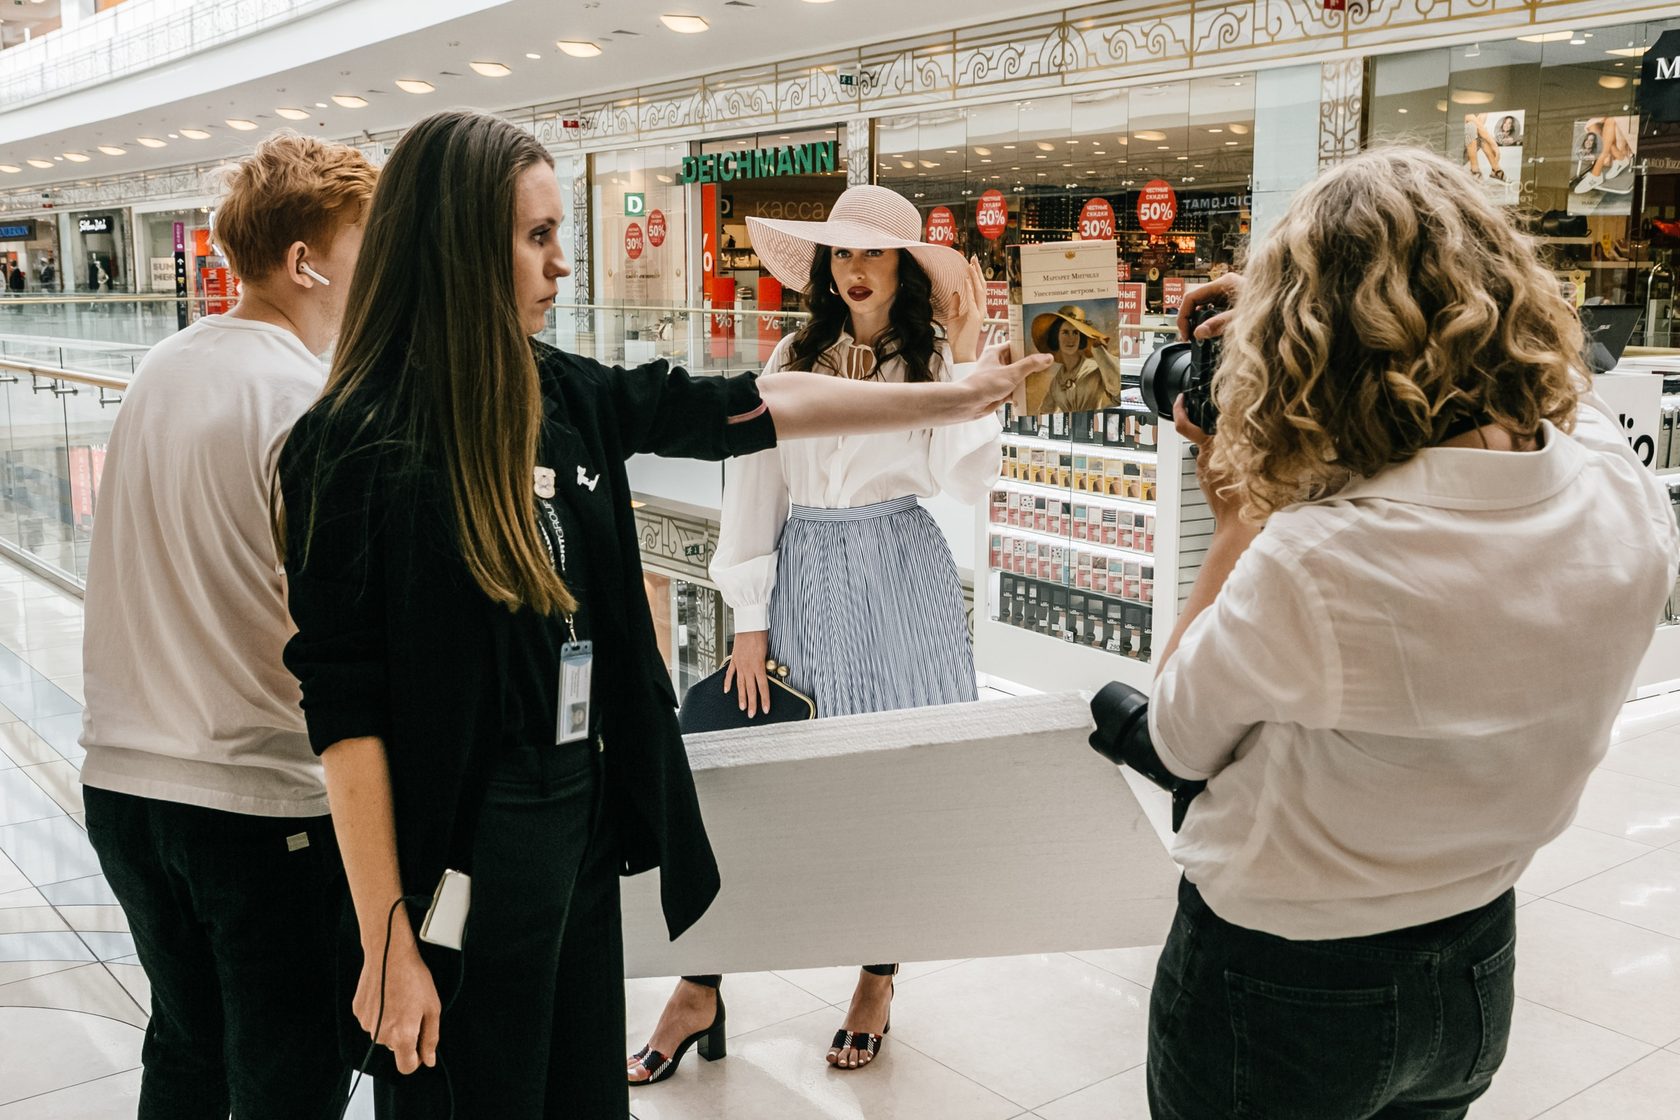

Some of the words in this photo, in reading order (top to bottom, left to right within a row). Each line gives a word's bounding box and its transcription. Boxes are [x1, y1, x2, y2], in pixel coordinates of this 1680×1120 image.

[681, 141, 836, 184] DEICHMANN
[627, 195, 643, 214] D
[1141, 202, 1173, 220] 50%
[979, 210, 1005, 225] 50%
[649, 225, 665, 237] 50%
[929, 226, 954, 241] 30%
[1081, 220, 1112, 236] 30%
[626, 238, 643, 250] 30%
